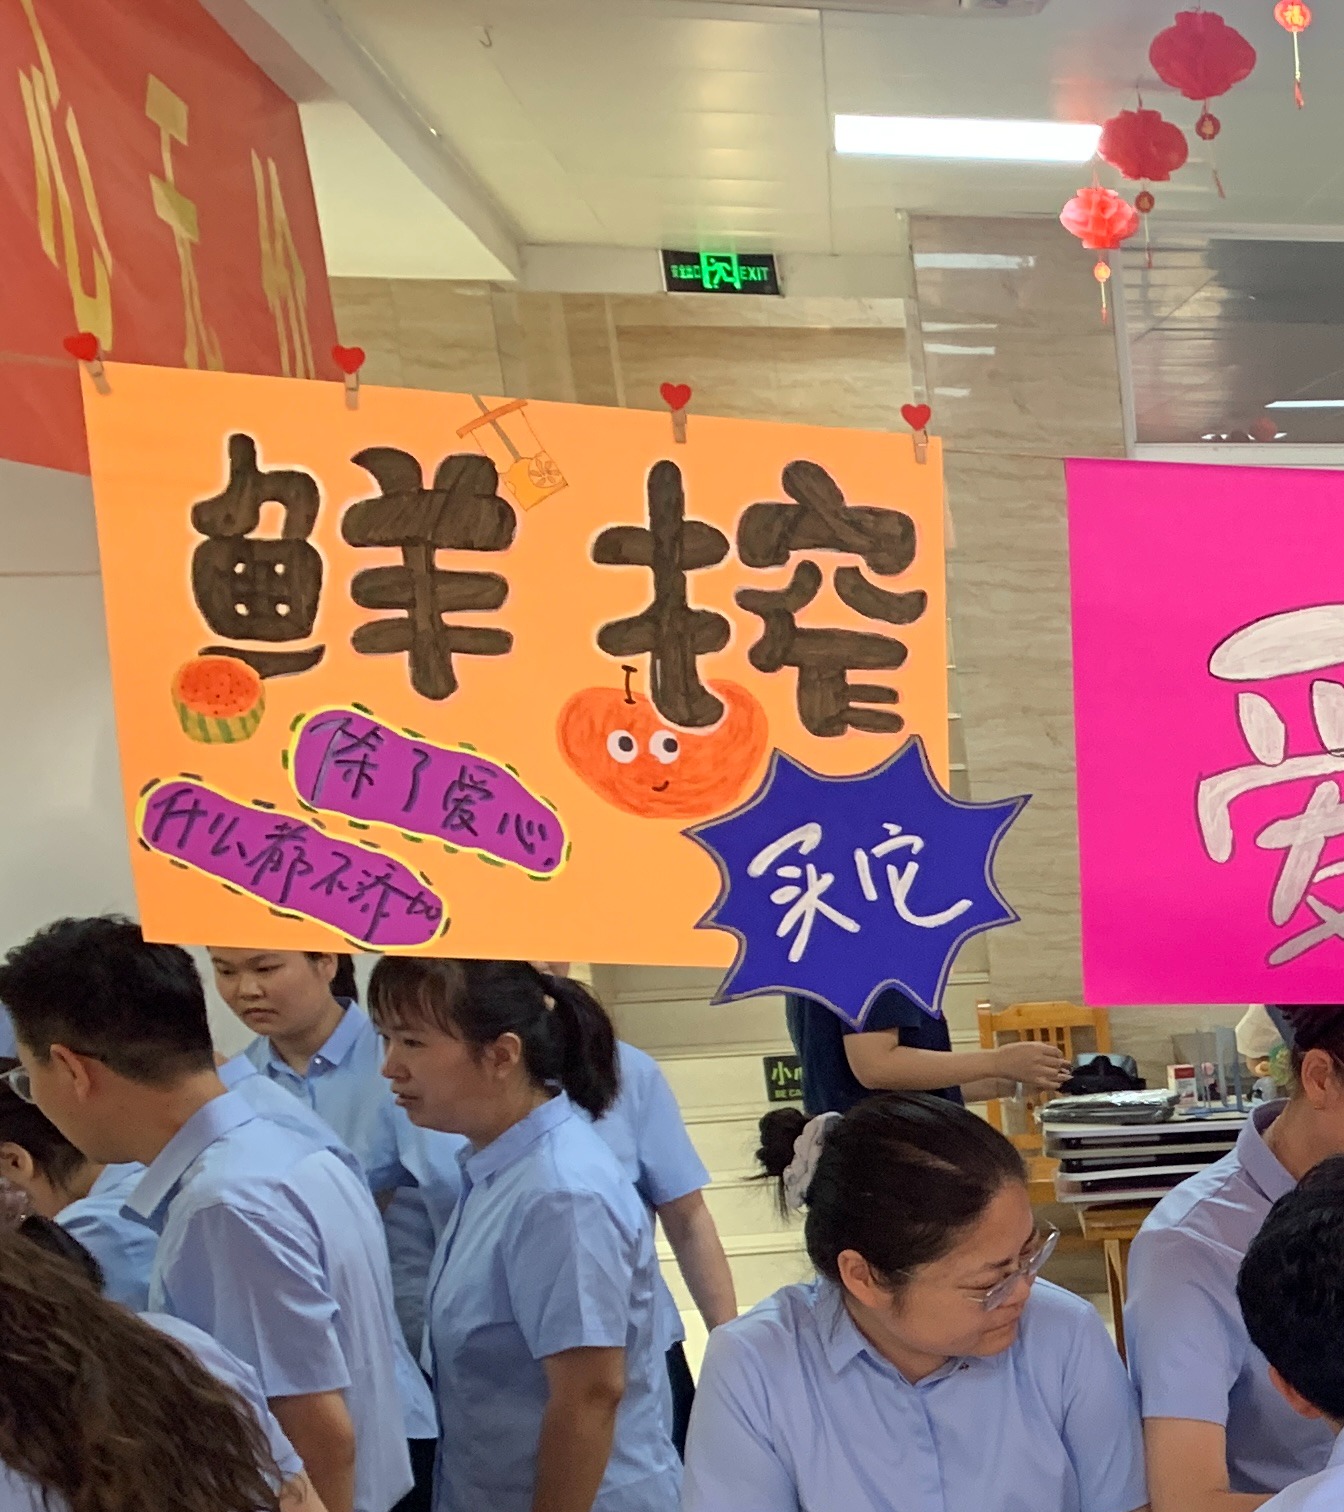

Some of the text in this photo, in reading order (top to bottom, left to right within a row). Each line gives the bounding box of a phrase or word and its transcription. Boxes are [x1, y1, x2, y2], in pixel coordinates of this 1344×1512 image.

[740, 266, 769, 281] EXIT
[190, 432, 928, 738] 鲜榨
[746, 822, 974, 963] 买它
